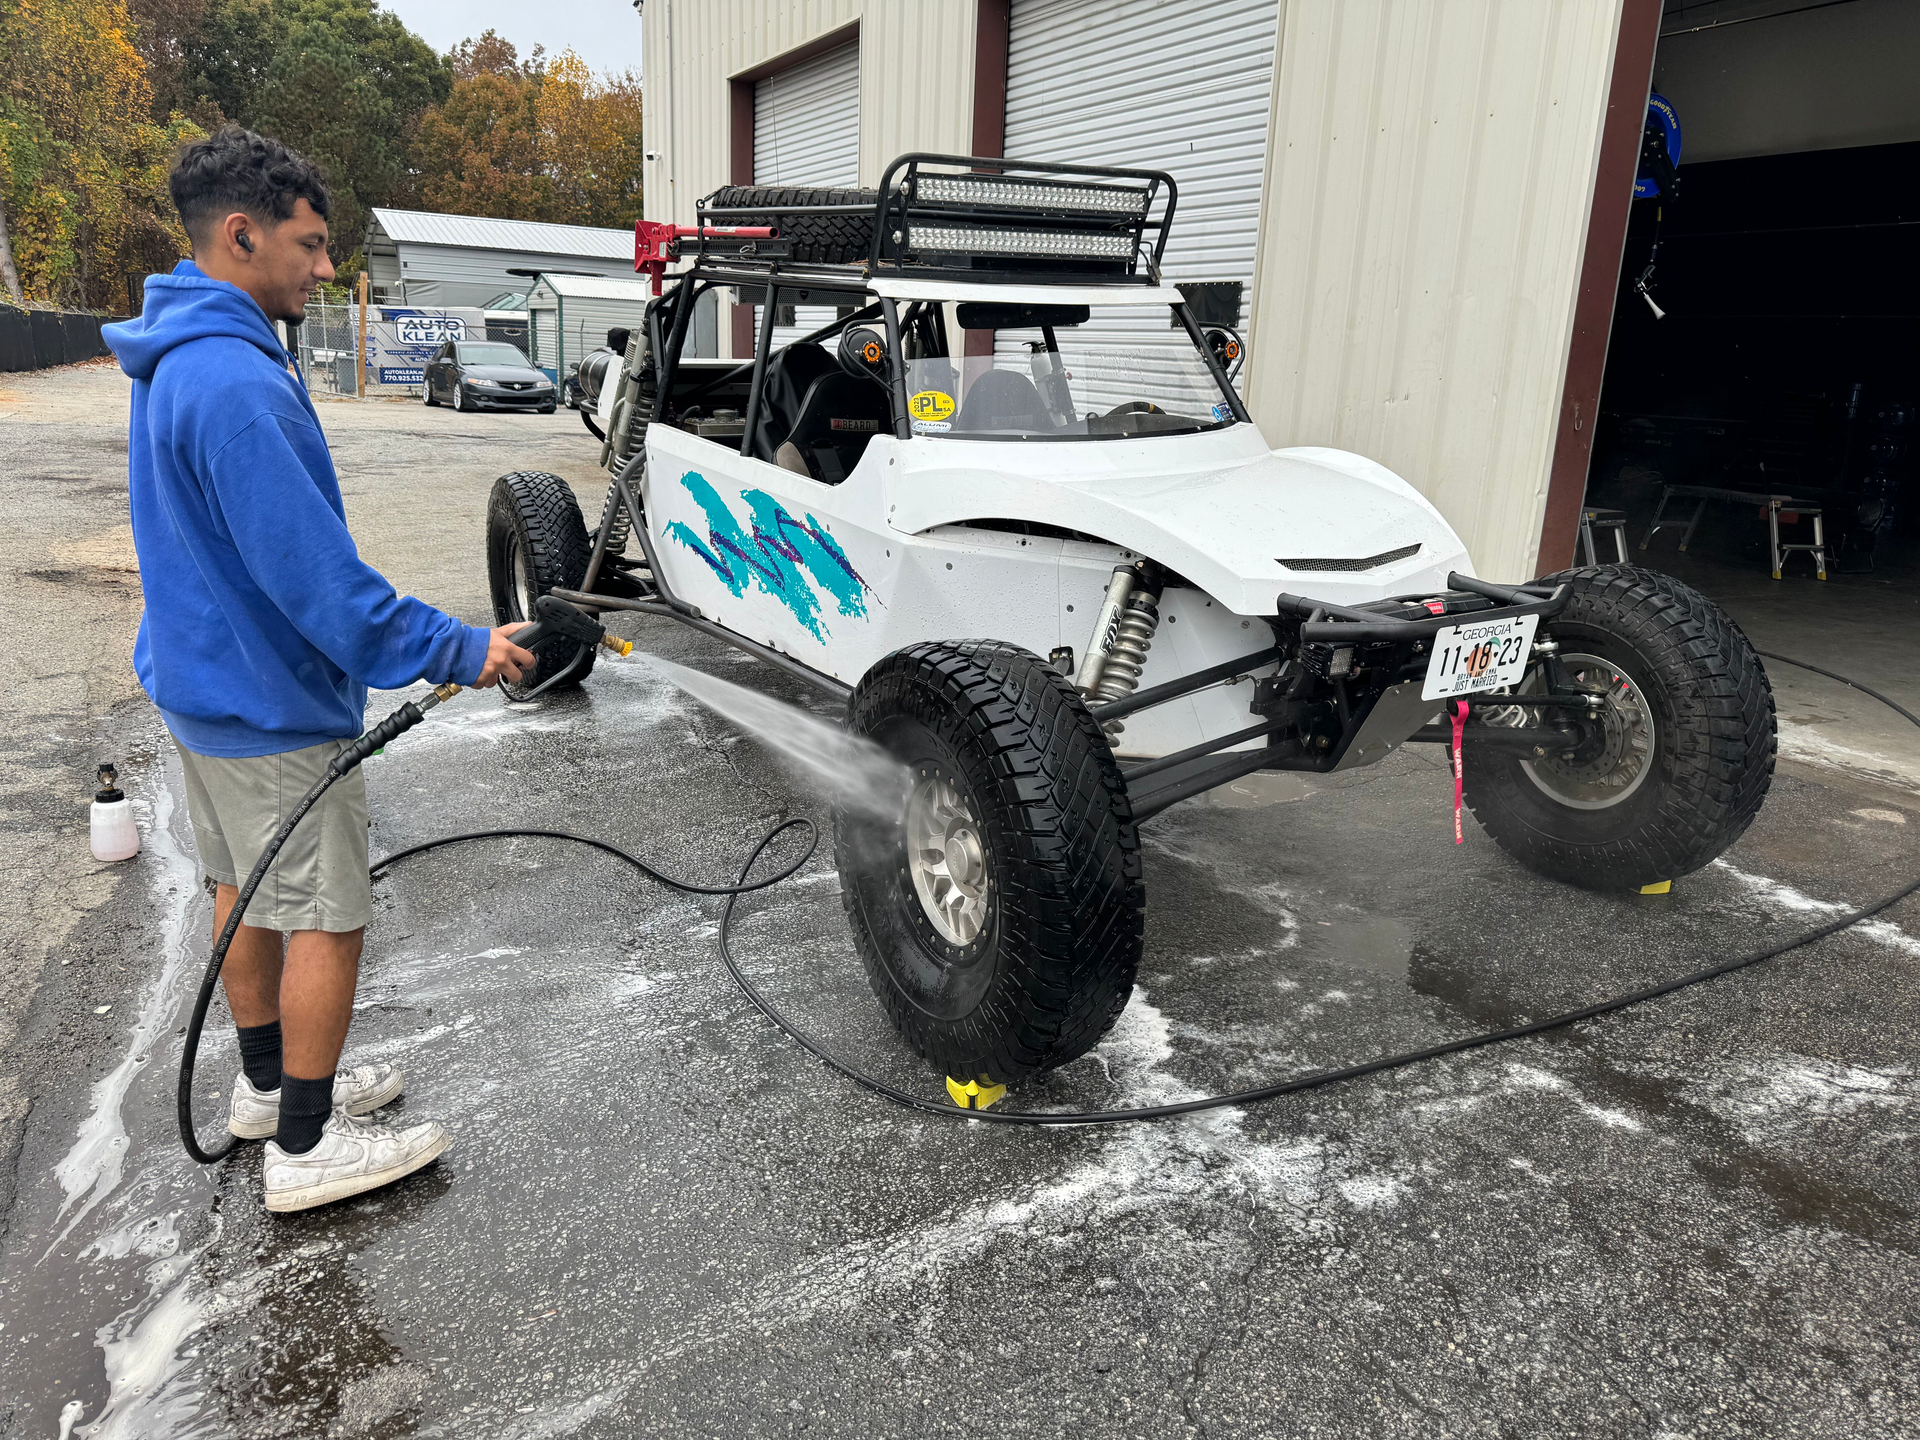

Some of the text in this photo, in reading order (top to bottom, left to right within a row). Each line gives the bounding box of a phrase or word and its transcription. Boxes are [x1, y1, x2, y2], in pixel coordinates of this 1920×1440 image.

[1649, 99, 1677, 130] GOODYEAR
[404, 319, 460, 330] AUTO
[403, 331, 460, 342] KLEAN
[919, 396, 943, 413] PL
[842, 420, 871, 430] BEARD
[1101, 605, 1123, 658] FOX
[1462, 624, 1511, 641] GEORGIA
[1457, 667, 1497, 681] BRYAN AND EMMA
[1452, 675, 1498, 692] JUST MARRIED
[1454, 747, 1462, 780] WARN
[207, 955, 222, 984] YAMATIC
[218, 937, 229, 954] HIGH
[226, 900, 246, 936] PRESSURE
[242, 870, 262, 900] WASHER
[259, 851, 274, 871] HOSE
[279, 823, 293, 840] INCH
[290, 800, 311, 823] 275BAR
[309, 777, 331, 800] 4000PSI
[293, 1195, 308, 1206] AIR
